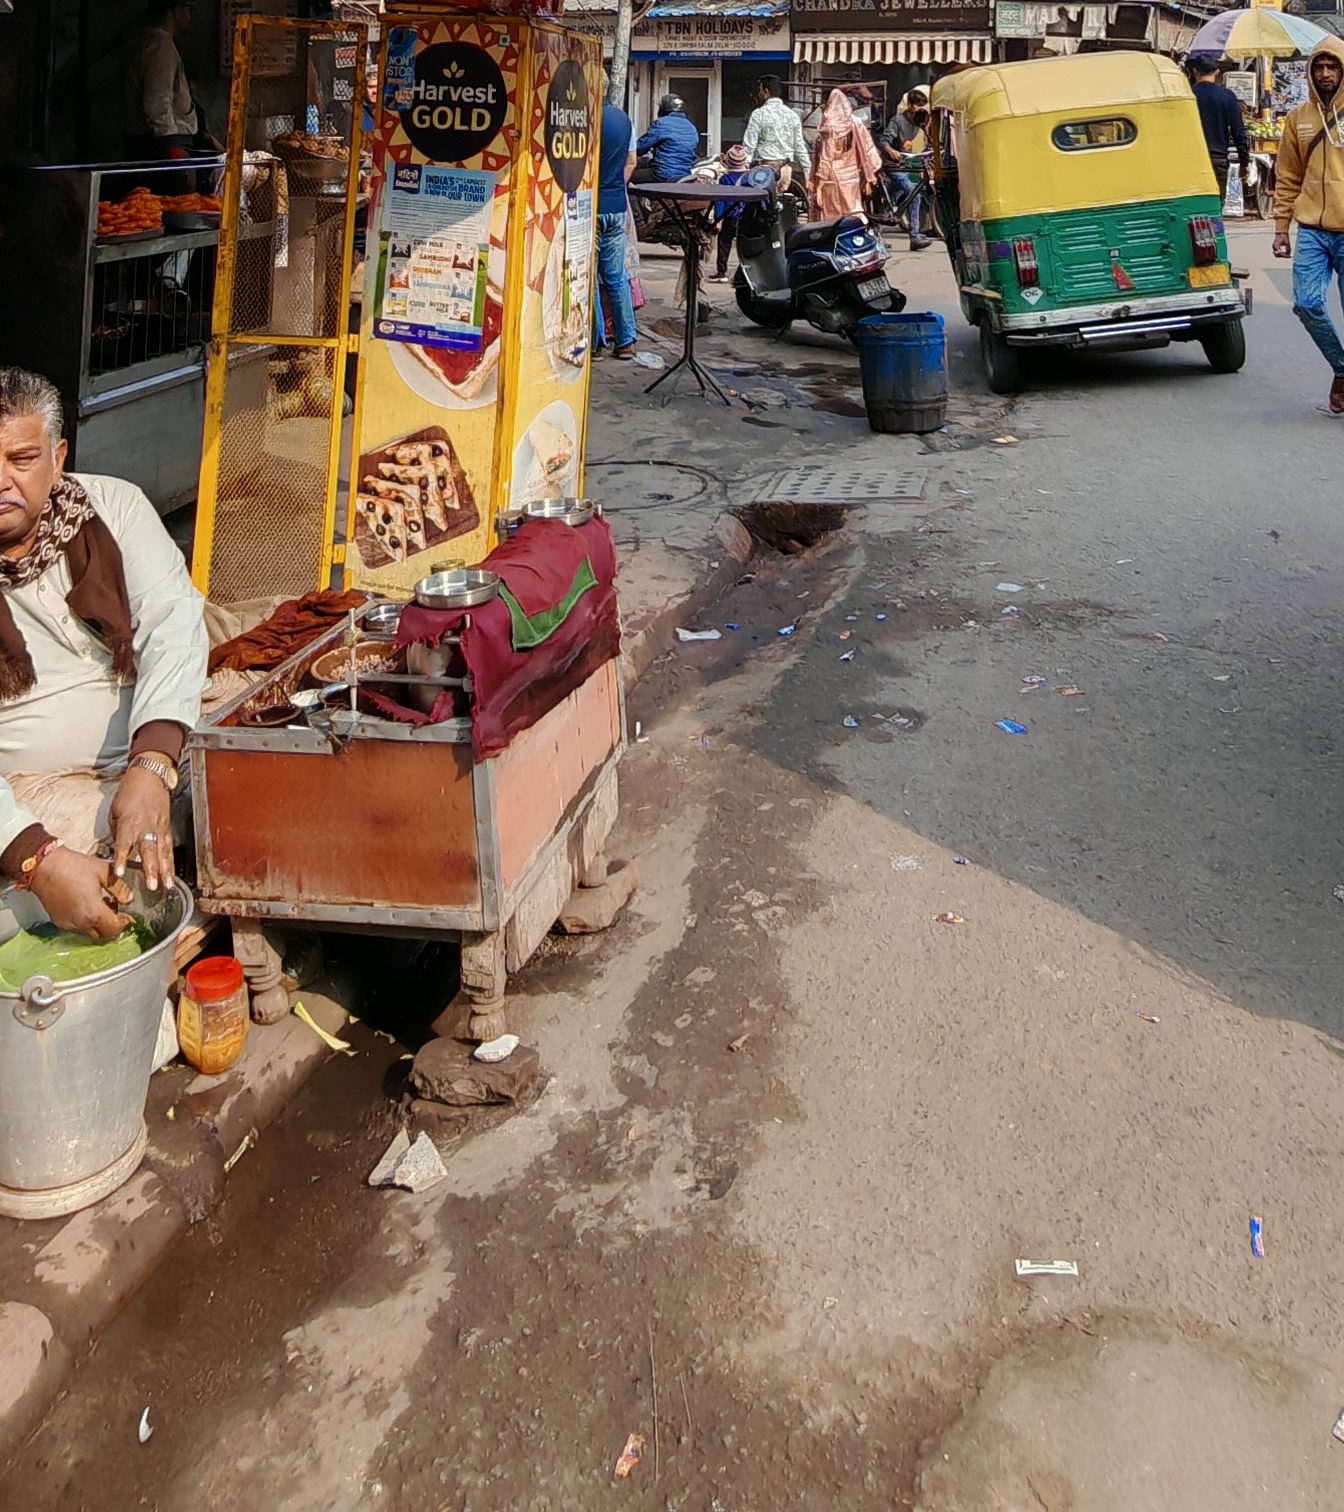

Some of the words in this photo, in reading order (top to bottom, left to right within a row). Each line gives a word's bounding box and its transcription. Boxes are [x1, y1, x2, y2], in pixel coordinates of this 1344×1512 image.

[665, 21, 691, 35] TBN
[697, 19, 754, 35] HOLIDAYS
[412, 79, 496, 104] Harvest
[412, 105, 491, 132] GOLD
[550, 101, 588, 128] Harvest
[552, 132, 586, 160] GOLD
[425, 174, 455, 185] INDIA'S
[458, 184, 485, 194] BRAND
[464, 193, 485, 202] TOWN
